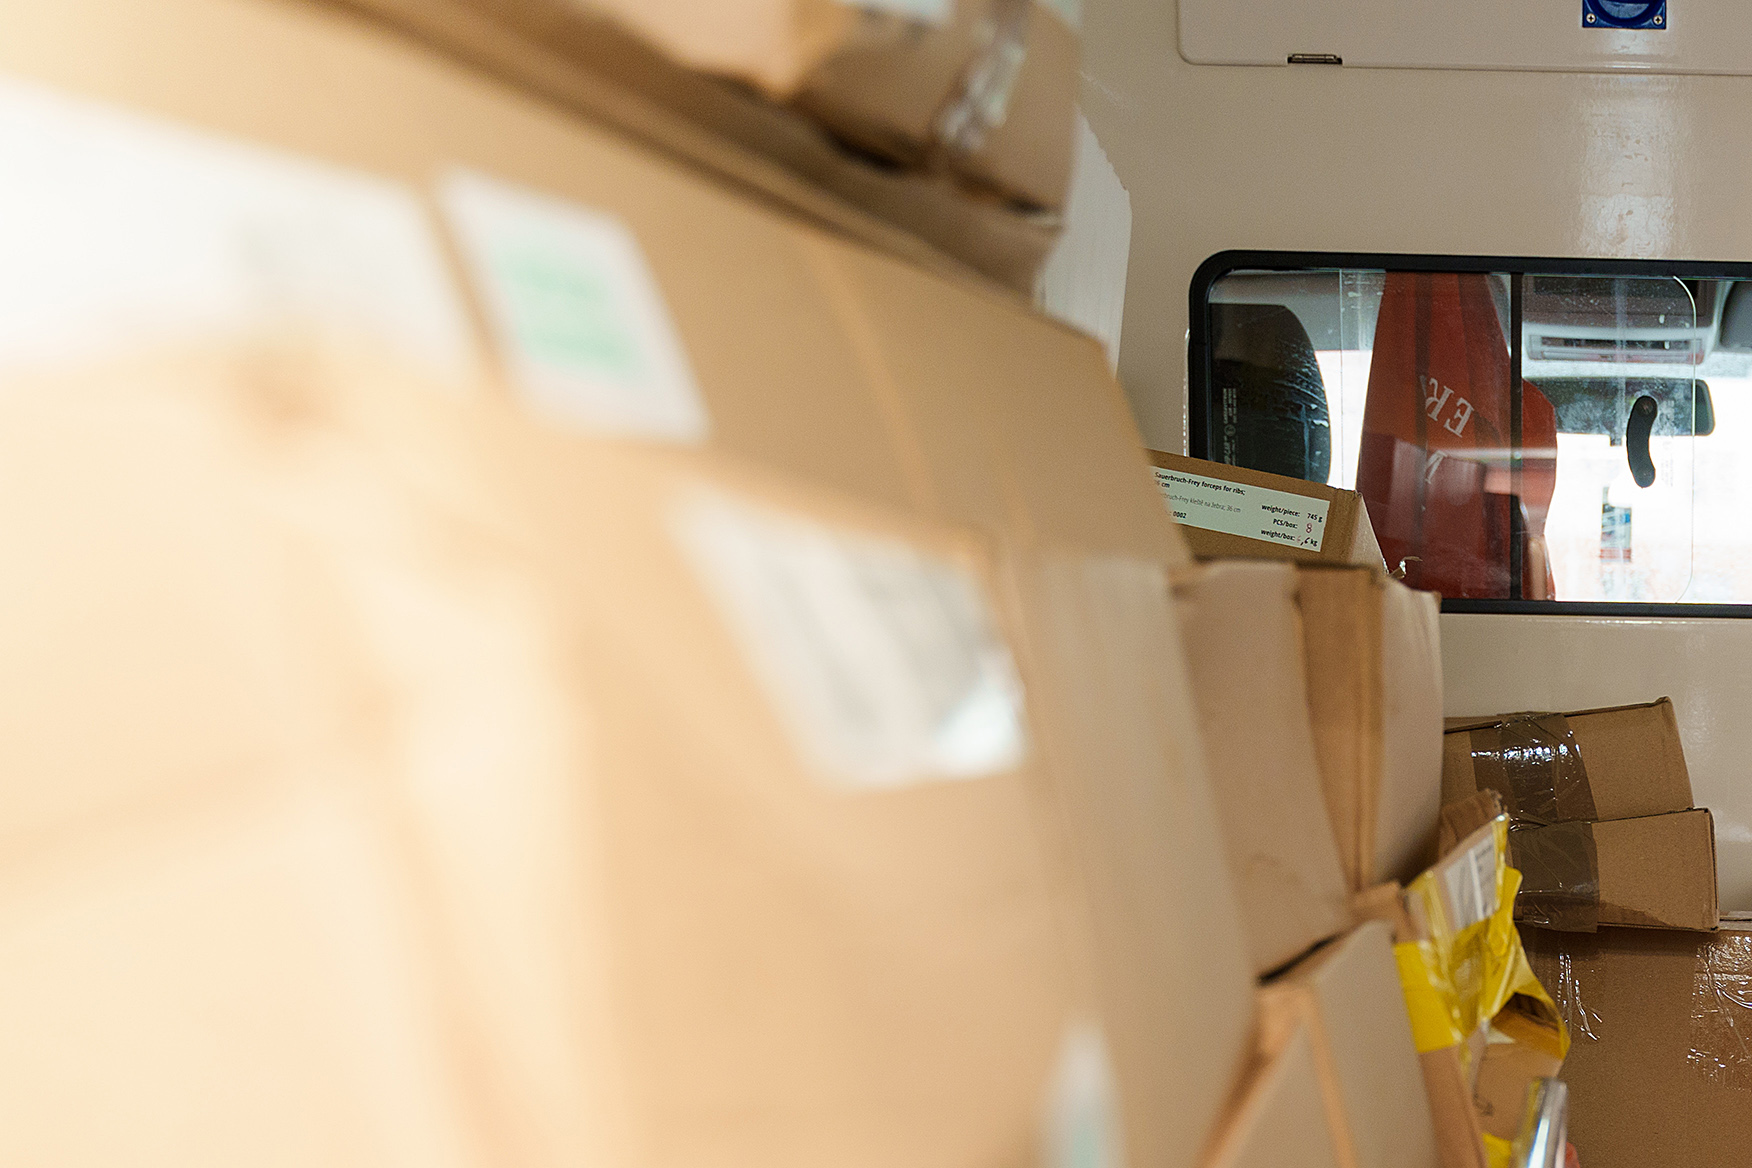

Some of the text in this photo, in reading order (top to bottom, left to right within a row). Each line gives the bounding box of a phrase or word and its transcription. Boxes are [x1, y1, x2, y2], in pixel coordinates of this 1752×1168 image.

[1155, 472, 1200, 488] Sauerbruch-Frey
[1201, 481, 1222, 491] forceps
[1232, 487, 1246, 495] ribs;
[1173, 511, 1187, 519] 0002
[1261, 505, 1300, 517] weight/piece:
[1307, 512, 1318, 521] 745
[1272, 518, 1312, 533] PCS/box: 8
[1261, 529, 1295, 541] weight/box:
[1310, 538, 1318, 547] kg
